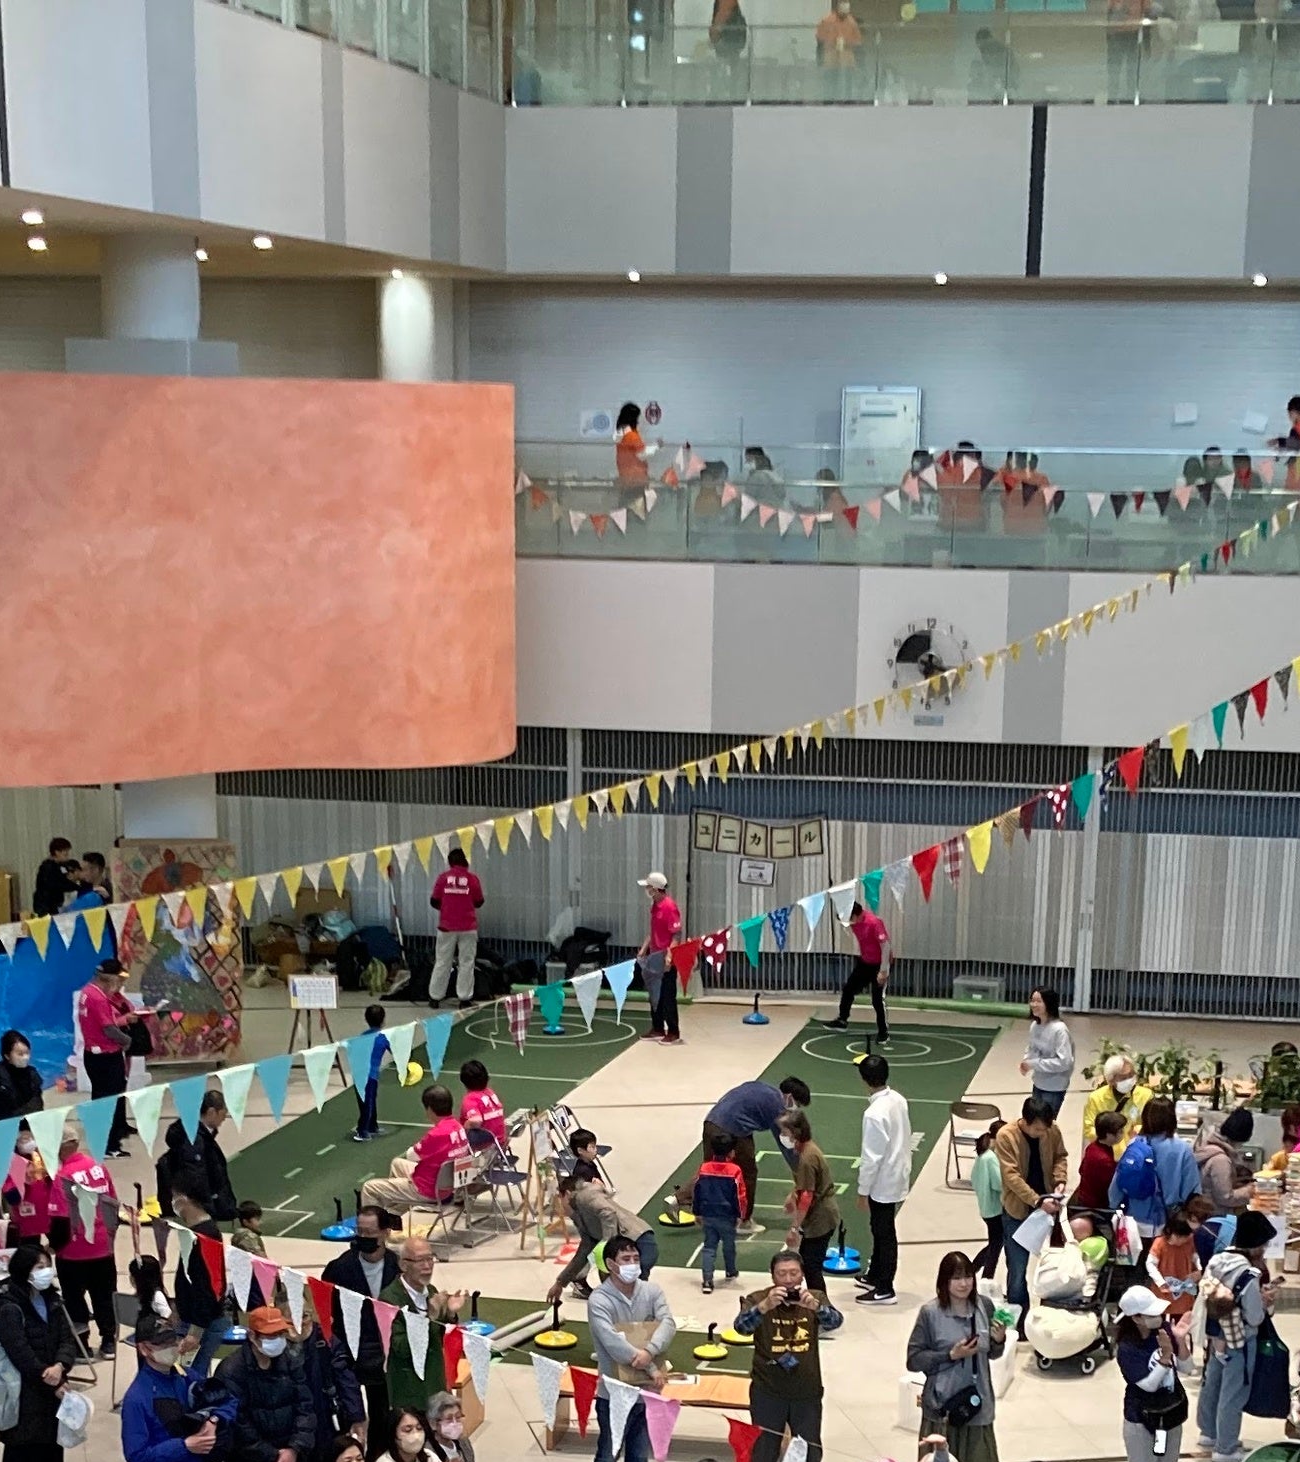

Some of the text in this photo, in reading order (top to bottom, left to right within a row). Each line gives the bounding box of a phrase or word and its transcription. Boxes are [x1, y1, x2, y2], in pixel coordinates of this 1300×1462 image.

[926, 618, 937, 630] 12
[700, 824, 817, 847] ユニカール
